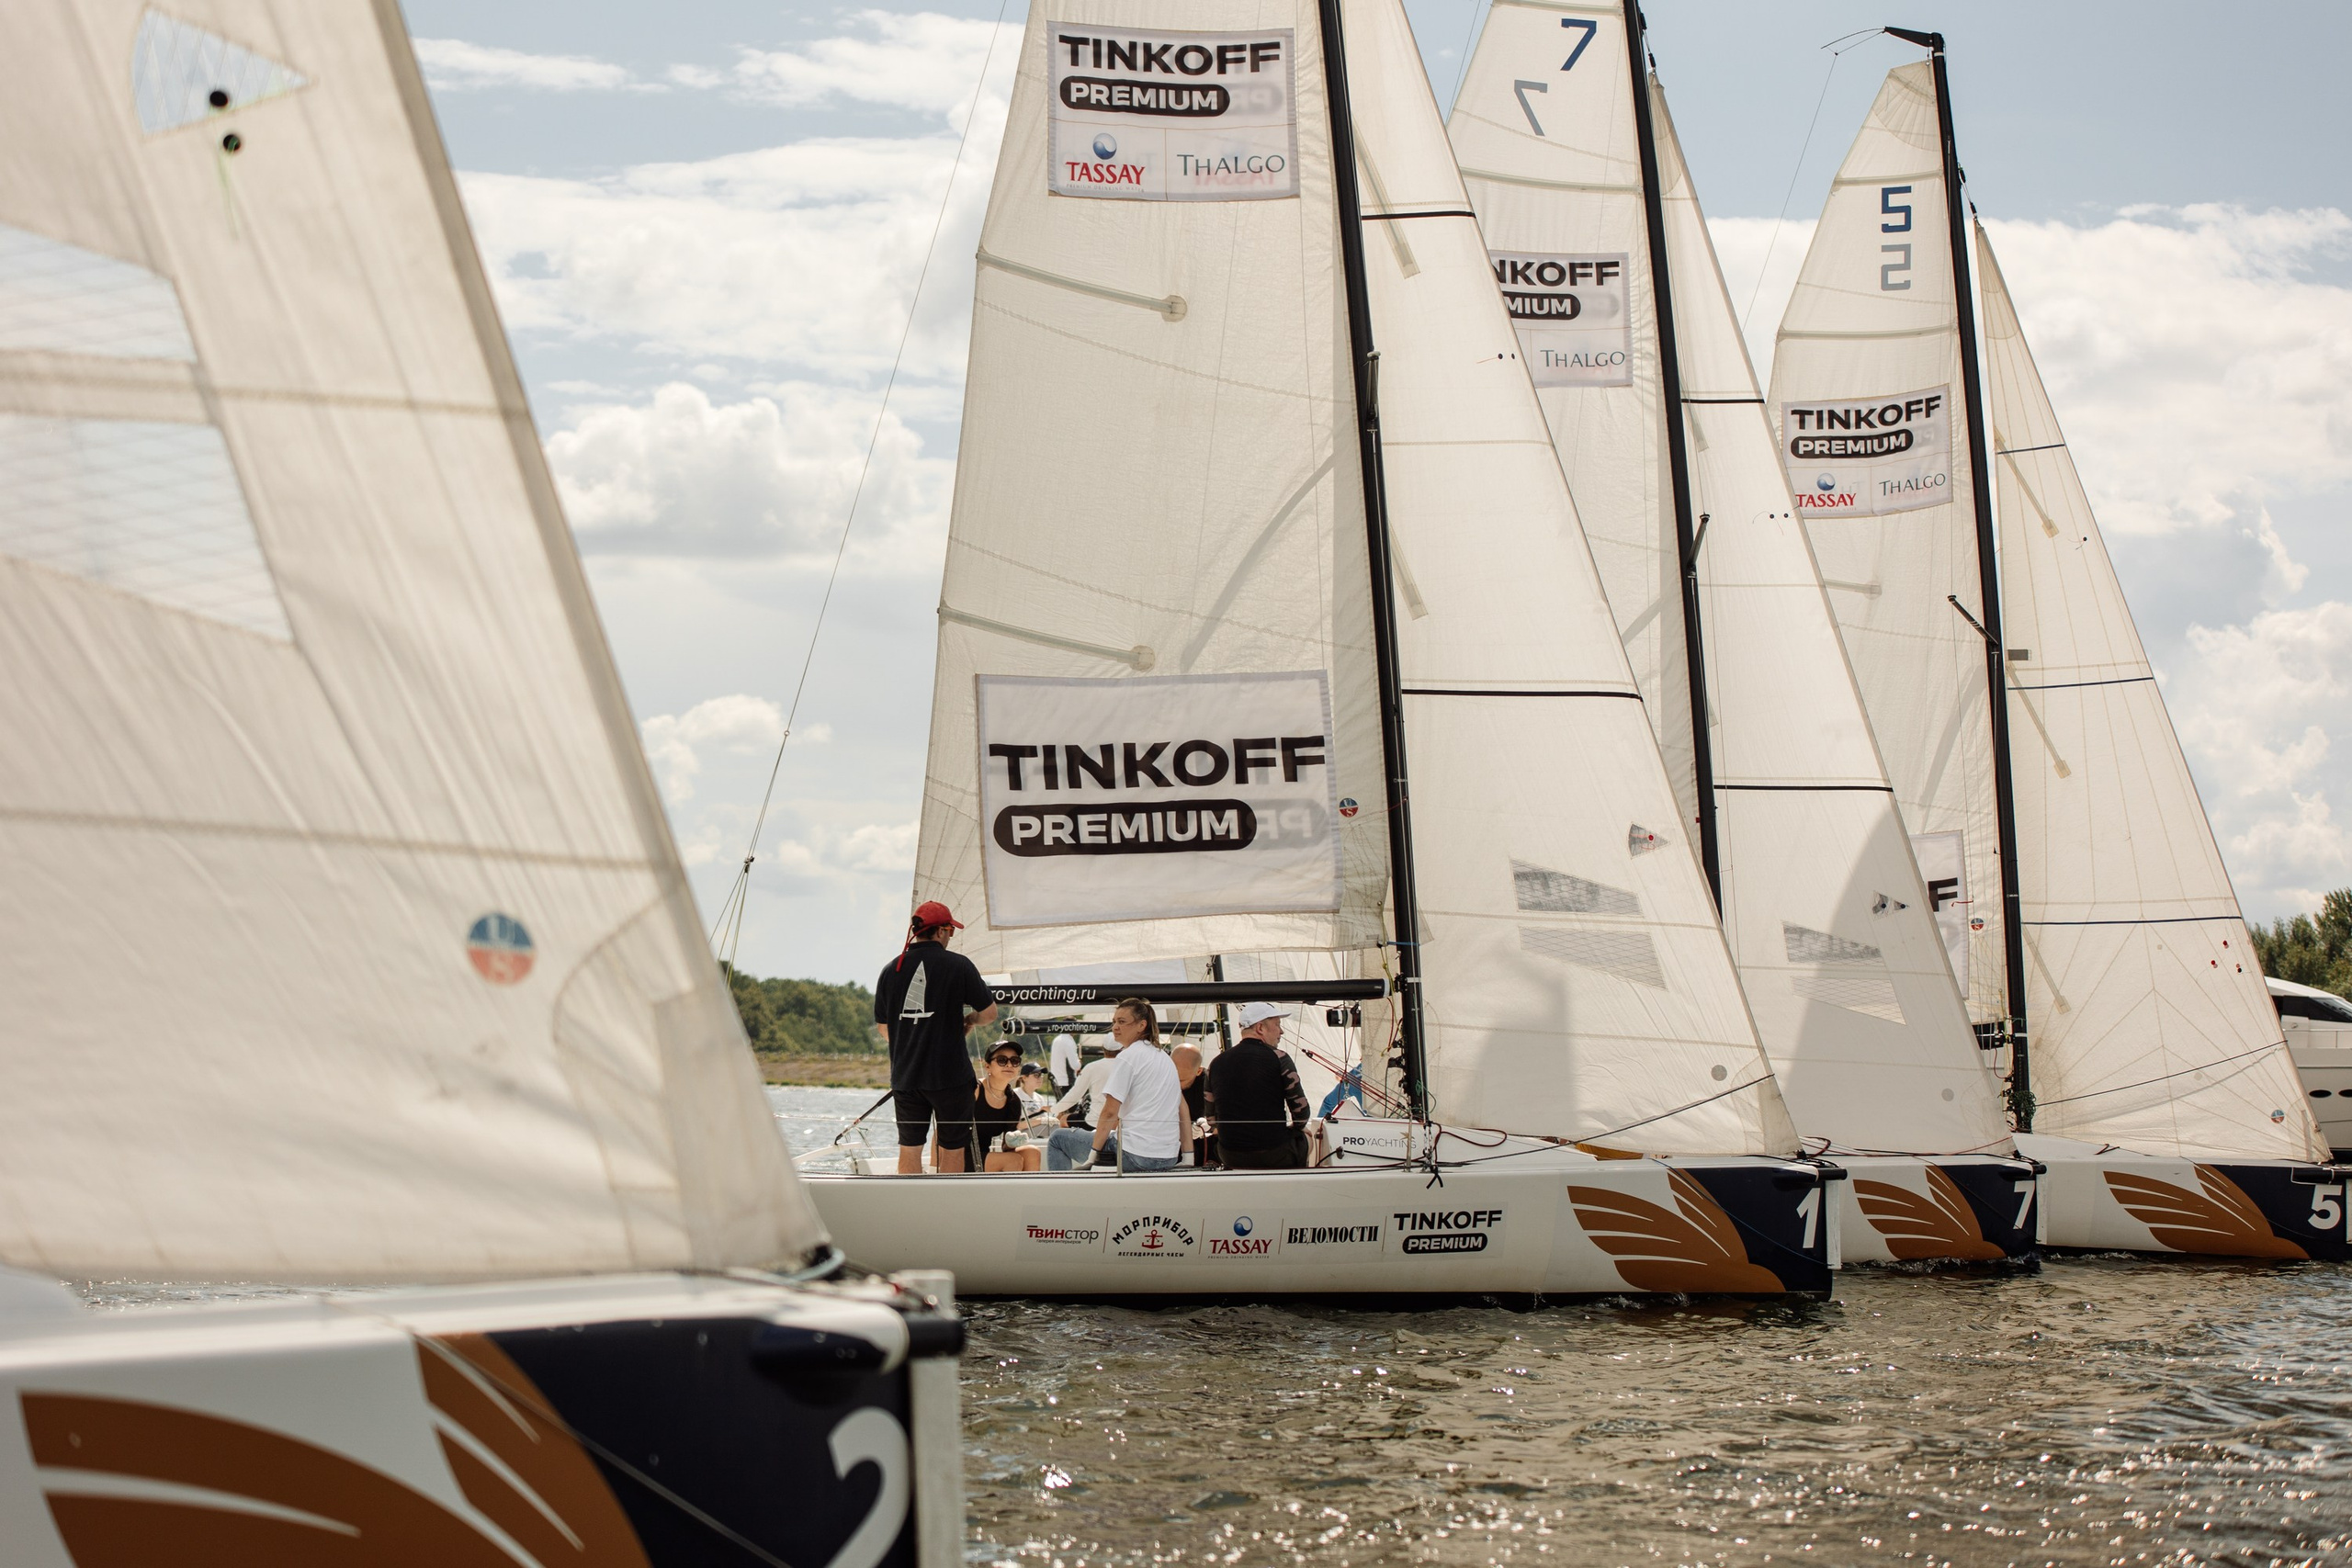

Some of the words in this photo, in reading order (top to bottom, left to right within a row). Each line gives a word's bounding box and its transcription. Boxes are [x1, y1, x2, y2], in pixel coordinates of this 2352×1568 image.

[1058, 34, 1281, 75] TINKOFF
[1560, 18, 1597, 71] 7
[1070, 82, 1218, 110] PREMIUM
[1065, 162, 1146, 186] TASSAY
[1177, 154, 1285, 176] THALGO
[1882, 186, 1912, 233] 5
[1540, 349, 1625, 367] THALGO
[1791, 395, 1941, 430] TINKOFF
[1798, 433, 1906, 455] PREMIUM
[1879, 473, 1946, 496] THALGO
[1795, 493, 1857, 508] TASSAY
[989, 736, 1326, 791] TINKOFF
[1010, 808, 1240, 846] PREMIUM
[1796, 1187, 1821, 1248] 1
[2012, 1180, 2036, 1229] 7
[2308, 1185, 2342, 1230] 5
[1112, 1216, 1194, 1246] МОРПРИБОР
[1287, 1224, 1380, 1246] ВЕДОМОСТИ
[1394, 1210, 1503, 1231] TINKOFF
[1209, 1239, 1273, 1254] TASSAY
[1408, 1236, 1483, 1250] PREMIUM
[827, 1406, 910, 1568] 2
